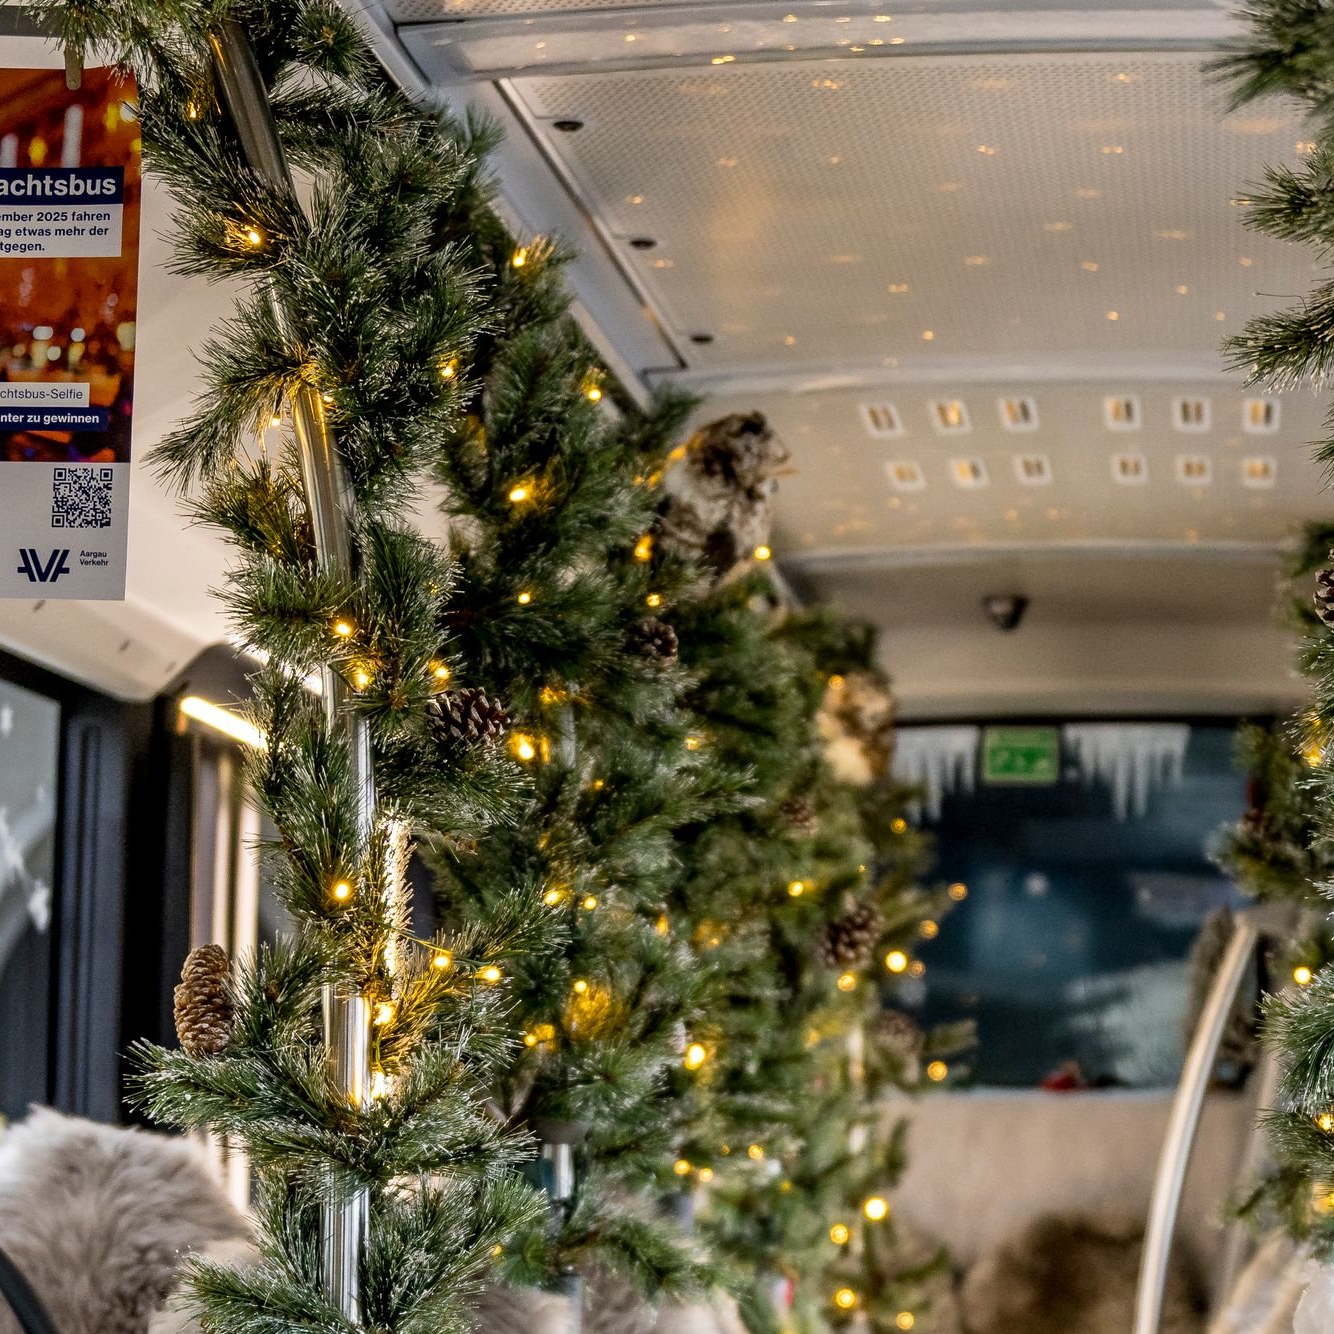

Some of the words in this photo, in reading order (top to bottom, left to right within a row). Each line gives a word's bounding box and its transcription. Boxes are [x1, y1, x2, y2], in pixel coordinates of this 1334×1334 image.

[36, 211, 68, 222] 2025
[71, 211, 111, 222] fahren
[14, 227, 52, 237] etwas
[54, 226, 85, 236] mehr
[88, 225, 109, 236] der
[27, 415, 40, 423] zu
[43, 414, 100, 425] gewinnen
[79, 550, 107, 559] Aargau
[79, 558, 109, 567] Verkehr
